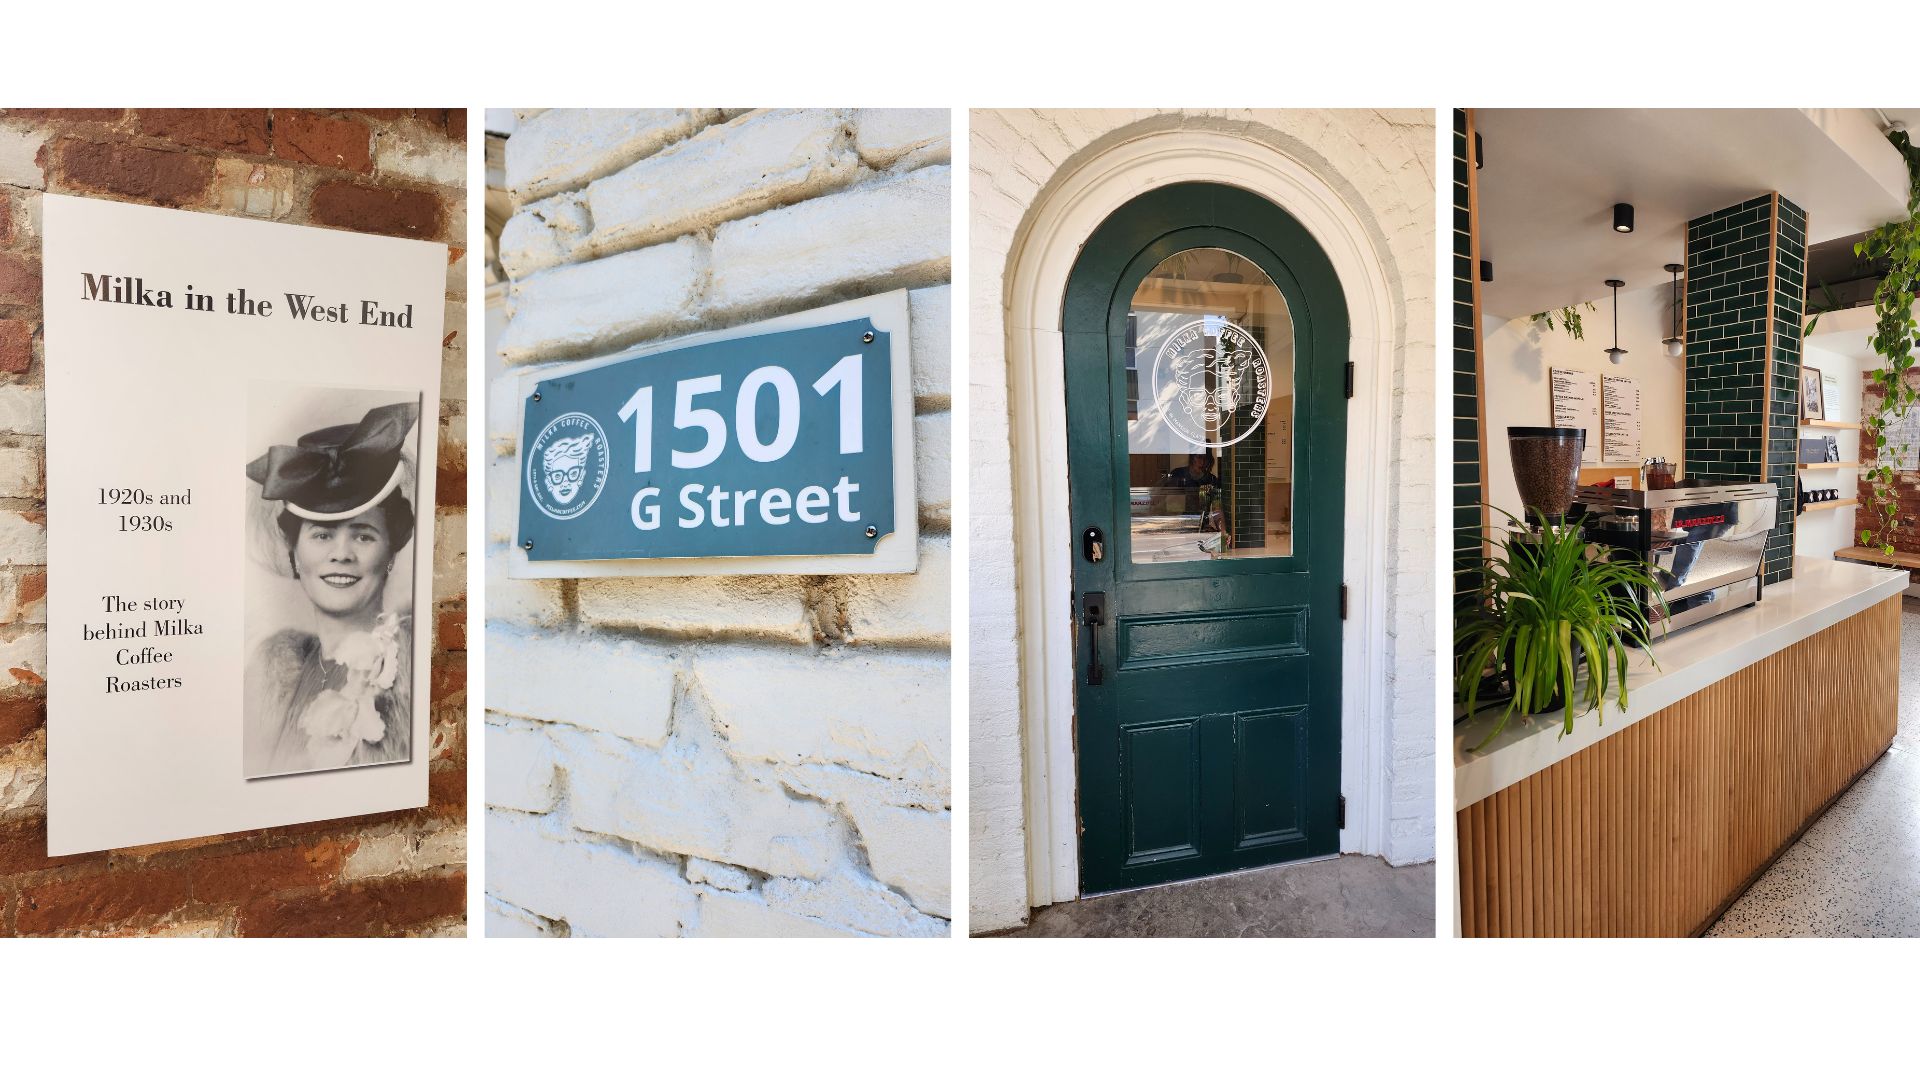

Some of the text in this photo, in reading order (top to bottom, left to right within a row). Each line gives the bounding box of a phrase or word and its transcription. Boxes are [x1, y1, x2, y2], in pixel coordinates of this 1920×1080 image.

[80, 272, 414, 330] Milka in the West End
[1165, 329, 1199, 360] MILKA
[1251, 357, 1267, 419] ROASTERS
[616, 352, 865, 474] 1501
[536, 418, 606, 489] MILKA COFFEE ROASTERS
[98, 487, 192, 506] 1920s and
[630, 476, 861, 531] G Street
[118, 515, 173, 532] 1930s
[102, 595, 185, 616] The story
[83, 618, 204, 641] behind Milka
[116, 646, 173, 666] Coffee
[105, 675, 182, 694] Roasters
